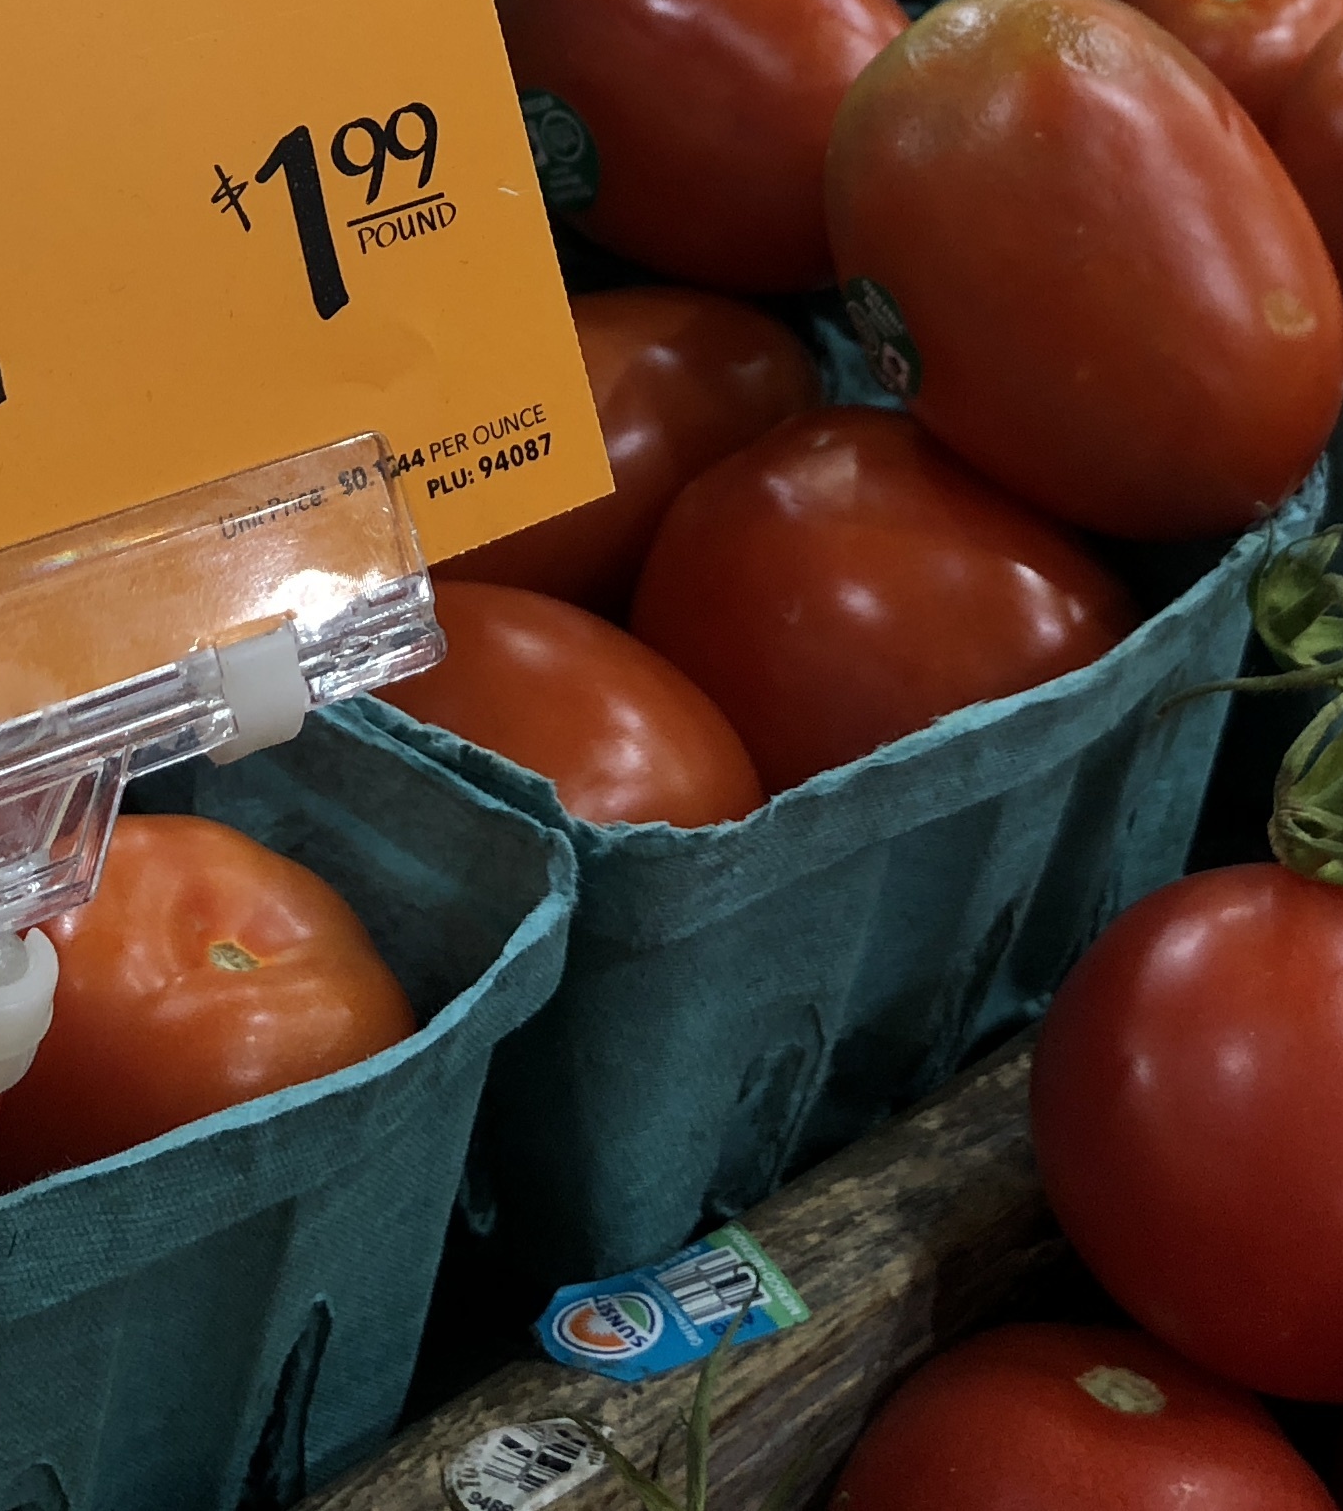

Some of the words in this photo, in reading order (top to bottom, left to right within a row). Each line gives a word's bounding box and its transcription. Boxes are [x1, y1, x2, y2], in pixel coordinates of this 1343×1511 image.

[356, 200, 458, 255] POUND
[428, 431, 470, 463] PER
[471, 403, 547, 446] OUNCE
[426, 467, 476, 500] PLU:
[477, 432, 552, 479] 94087
[594, 1294, 649, 1349] SUNSET
